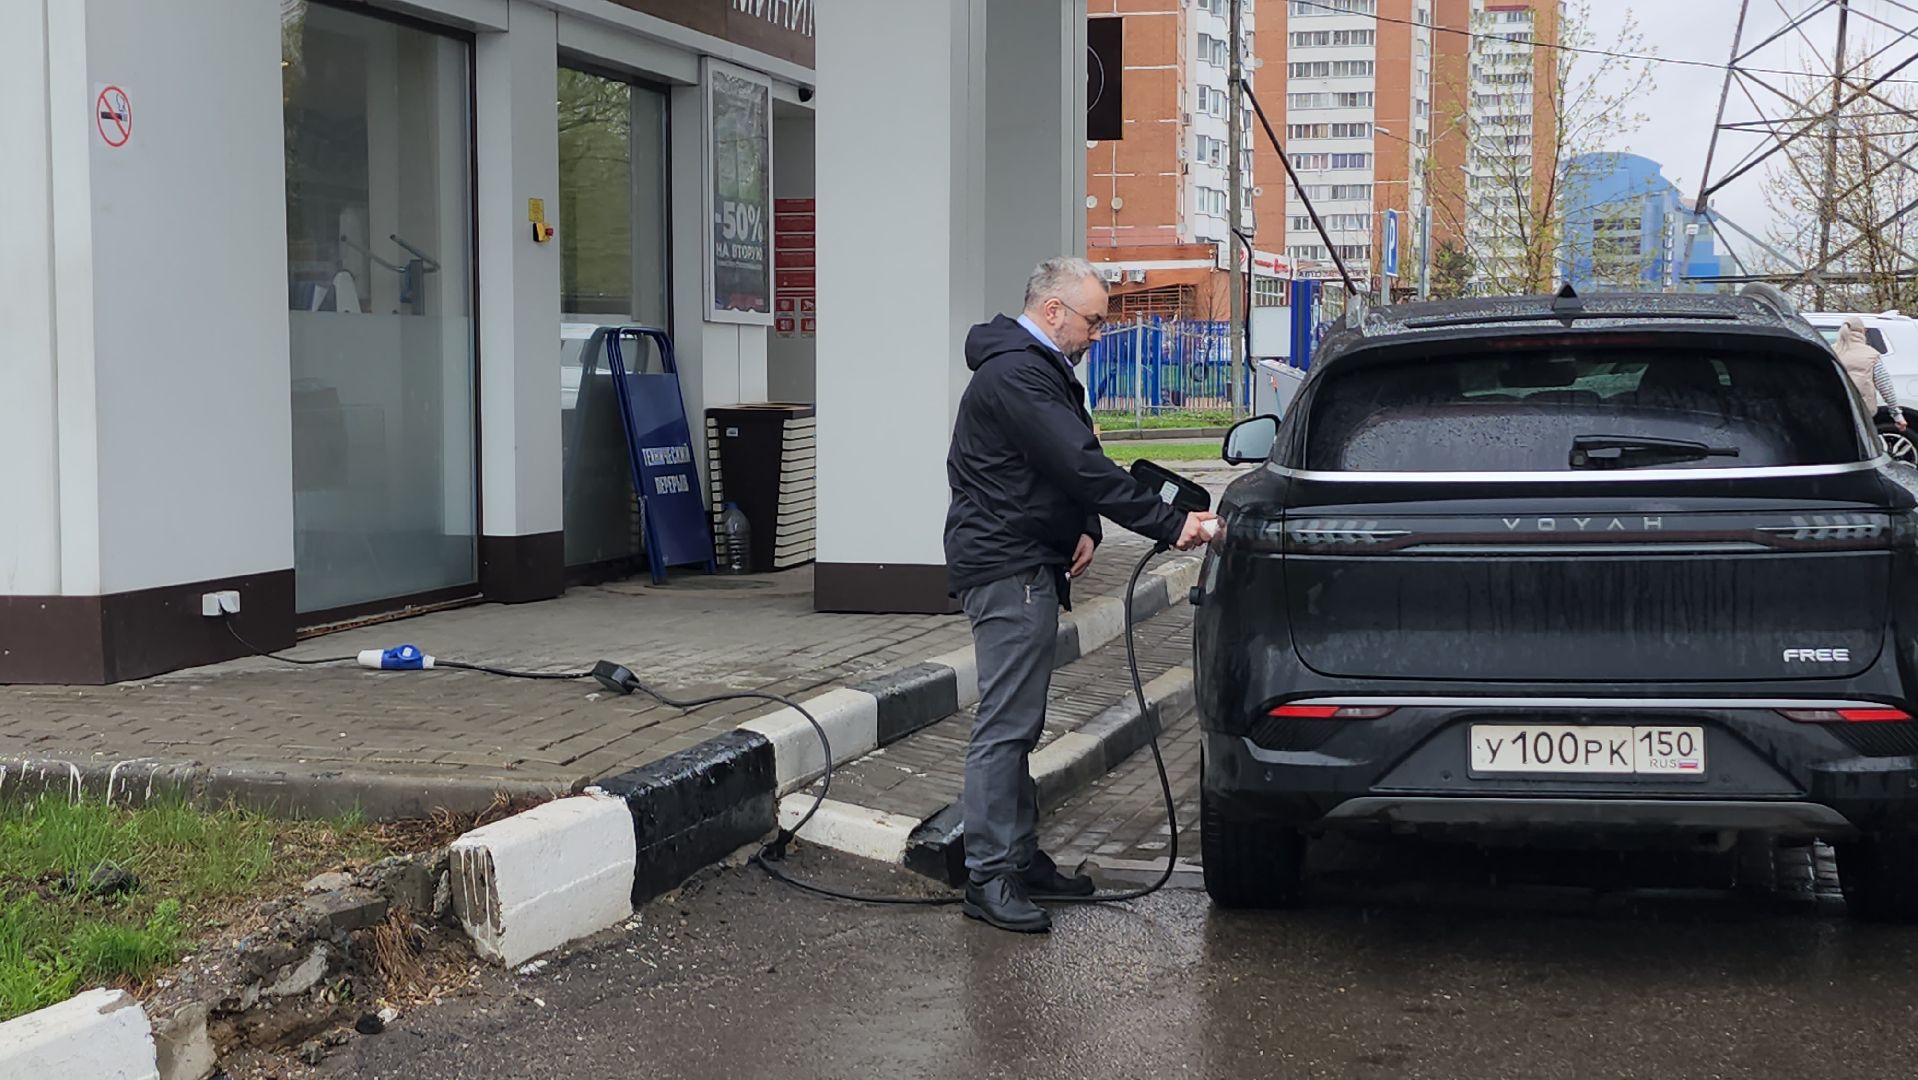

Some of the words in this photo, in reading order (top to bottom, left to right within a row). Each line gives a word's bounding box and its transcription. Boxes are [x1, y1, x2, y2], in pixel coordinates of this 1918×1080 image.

[715, 200, 763, 243] -50%
[716, 242, 730, 258] НА
[1388, 217, 1396, 268] P
[1502, 516, 1662, 531] VOYAH
[1783, 648, 1850, 663] FREE
[1639, 731, 1694, 757] 150
[1650, 759, 1677, 769] RUS
